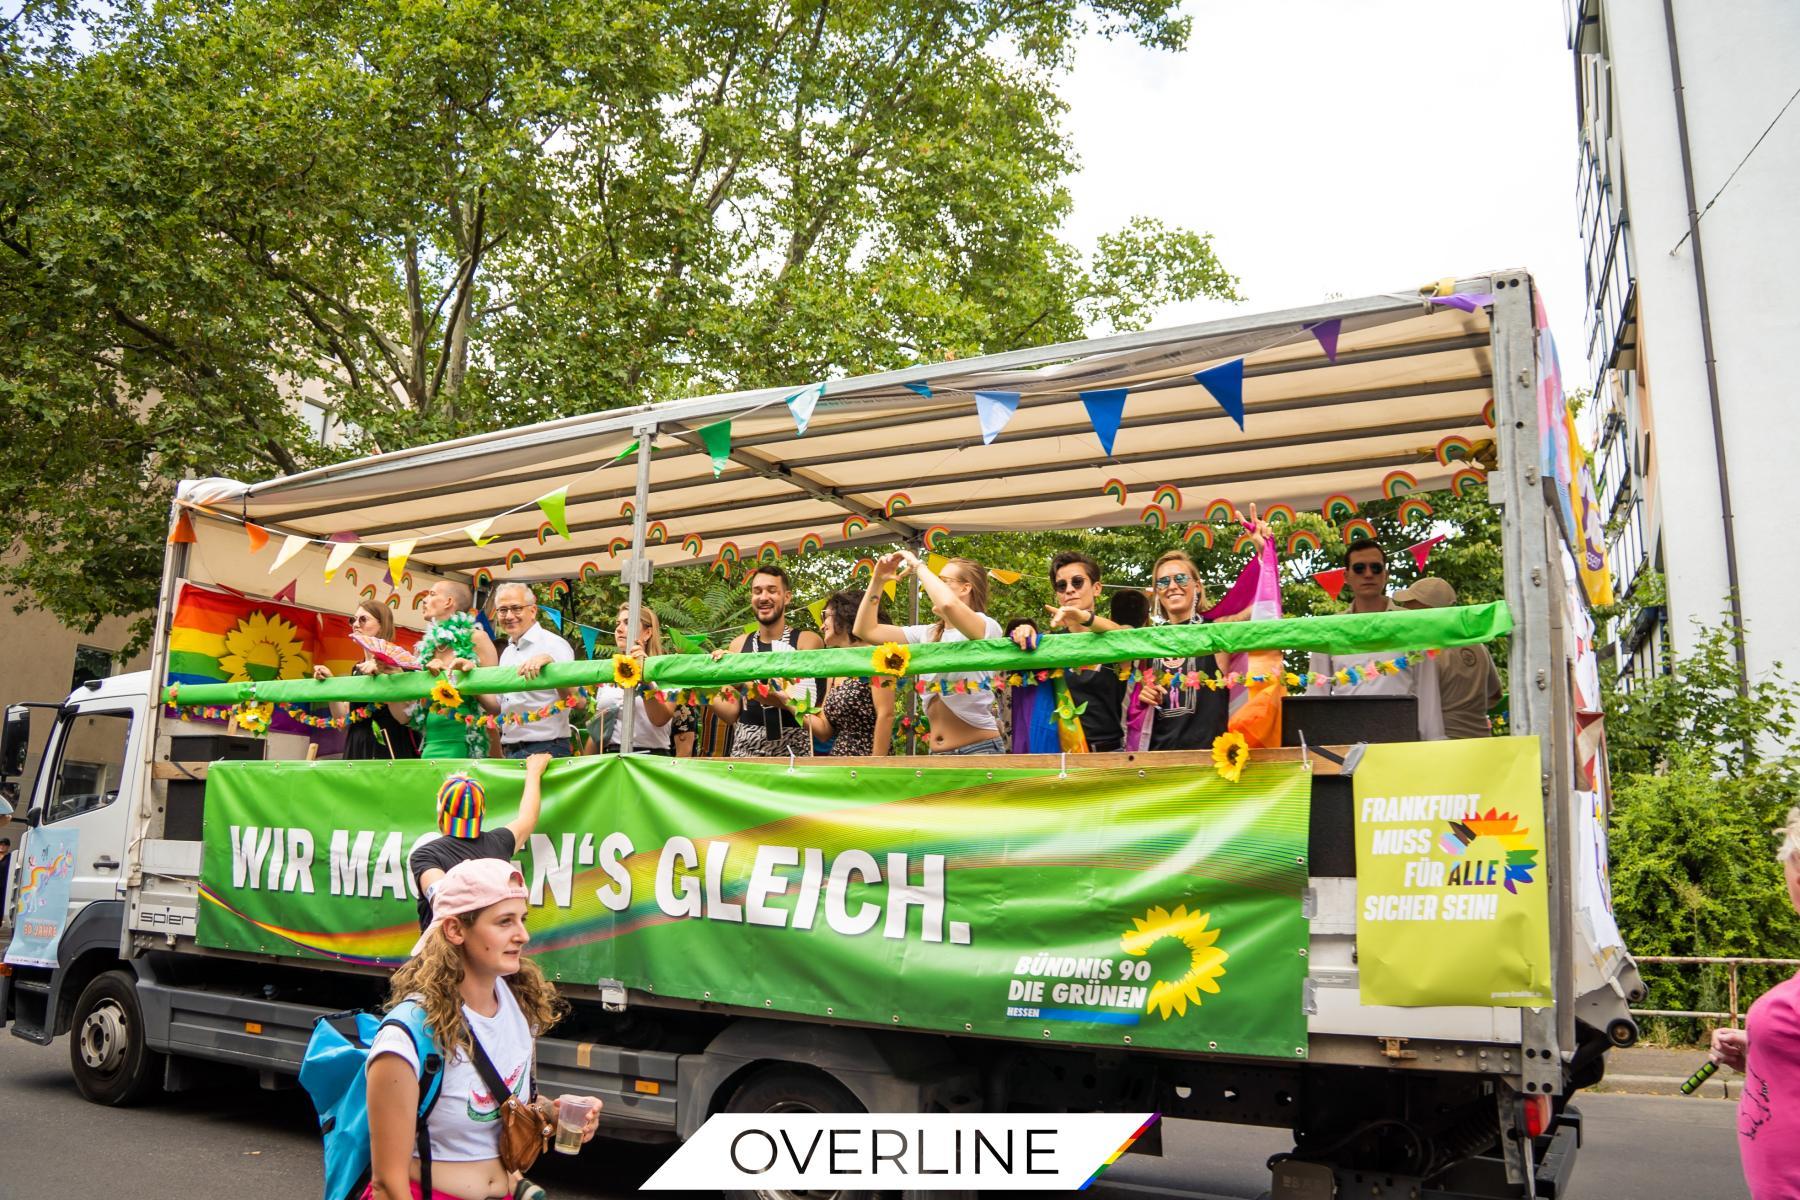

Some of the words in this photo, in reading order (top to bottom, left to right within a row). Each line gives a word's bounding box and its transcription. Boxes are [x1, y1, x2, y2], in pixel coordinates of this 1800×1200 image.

[1361, 794, 1481, 823] FRANKFURT
[1372, 828, 1432, 855] MUSS
[229, 825, 315, 894] WIR
[330, 829, 635, 912] MAN‘S
[654, 836, 972, 945] GLEICH.
[1404, 858, 1445, 888] FÜR
[1447, 860, 1500, 886] ALLE
[140, 907, 196, 927] spier
[1363, 895, 1439, 921] SICHER
[1442, 894, 1499, 921] SEIN!
[1014, 953, 1113, 980] BÜNDNIS
[1118, 960, 1152, 982] 90
[1008, 980, 1046, 1002] DIE
[1051, 979, 1148, 1009] GRÜNEN
[1006, 1006, 1040, 1018] HESSEN
